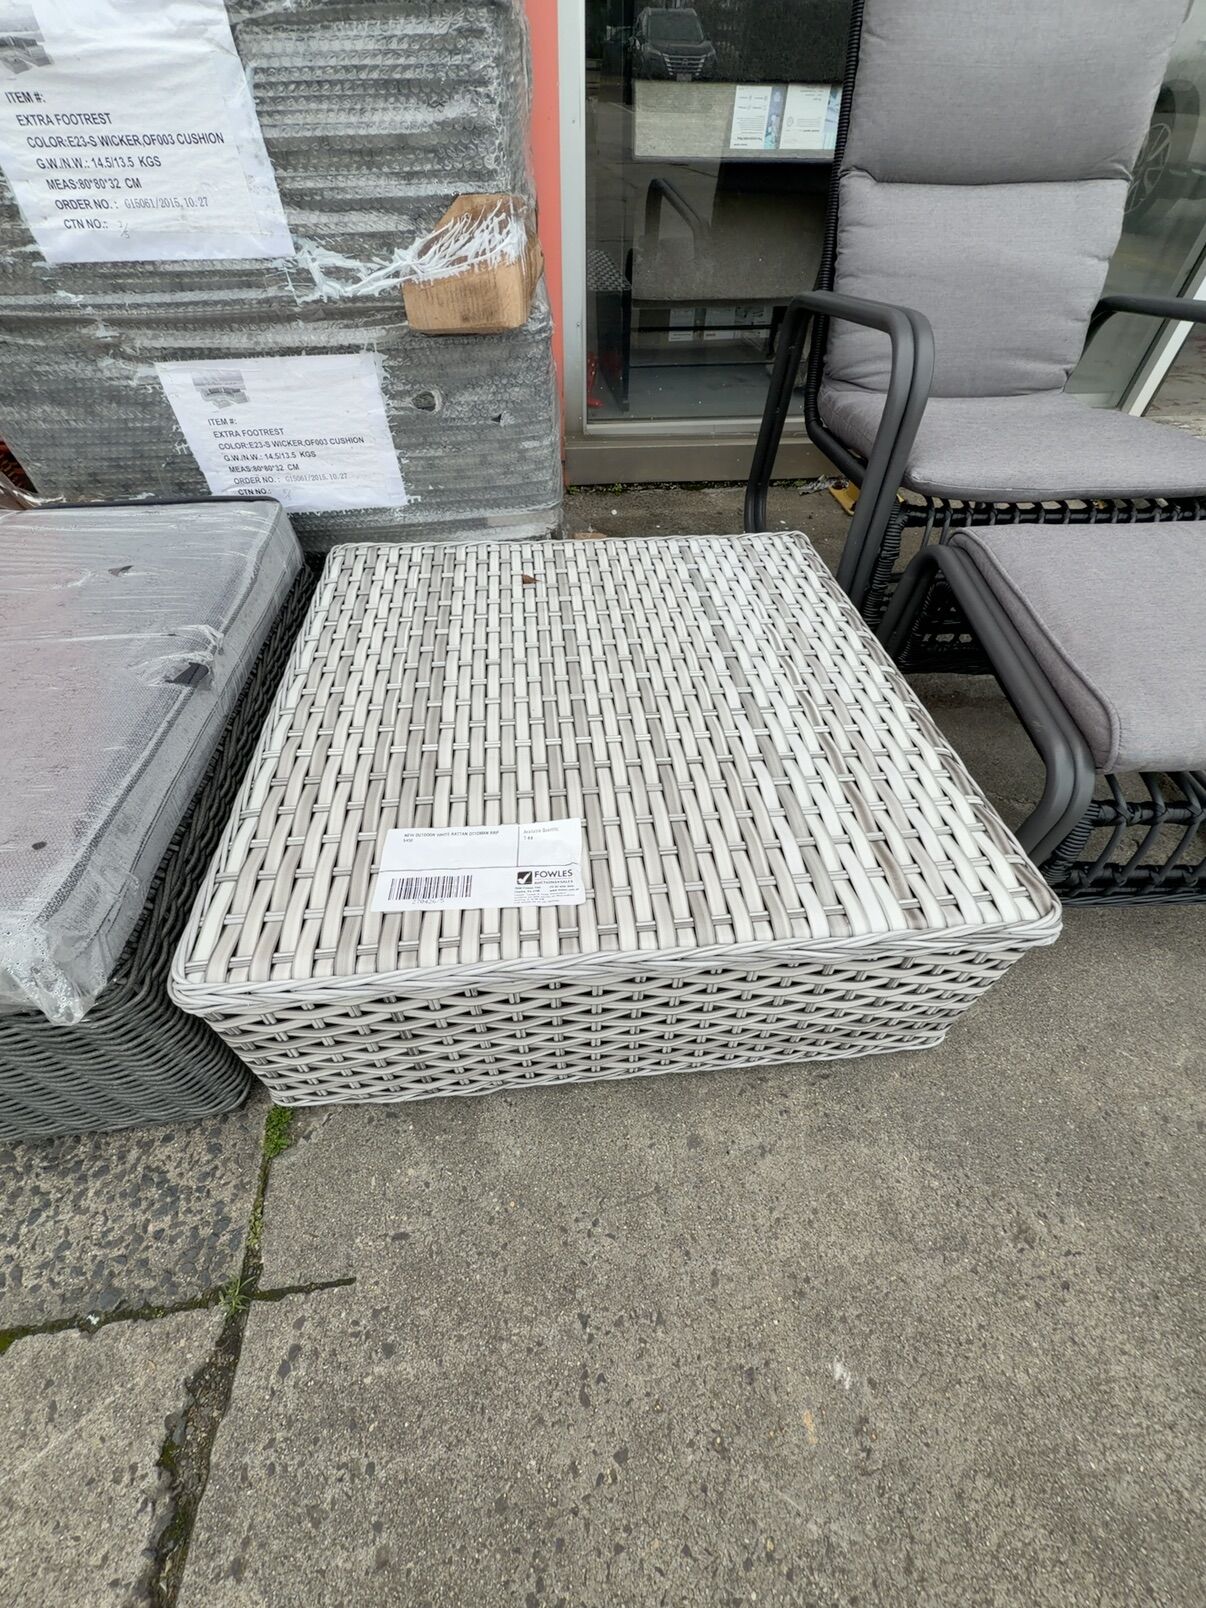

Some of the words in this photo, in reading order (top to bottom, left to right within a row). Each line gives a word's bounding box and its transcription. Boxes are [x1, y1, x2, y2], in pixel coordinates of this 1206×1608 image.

[5, 92, 33, 104] ITEM
[16, 114, 54, 126] EXTRA
[55, 113, 112, 125] FOOTREST
[27, 136, 98, 149] COLOR:E23-S
[176, 132, 225, 145] CUSHION
[92, 157, 135, 169] 14.5/13.5
[139, 156, 162, 168] KGS
[125, 178, 142, 189] CM
[55, 199, 93, 210] ORDER
[63, 219, 85, 230] CTN
[208, 418, 227, 426] ITEM
[213, 430, 240, 438] EXTRA
[242, 428, 284, 437] FOOTREST
[218, 442, 271, 450] COLOR:E23-S
[329, 437, 364, 445] CUSHION
[264, 452, 296, 460] 14.5/13.5
[299, 451, 317, 459] KGS
[287, 463, 300, 471] CM
[234, 476, 260, 485] ORDER
[534, 869, 573, 878] FOWLES
